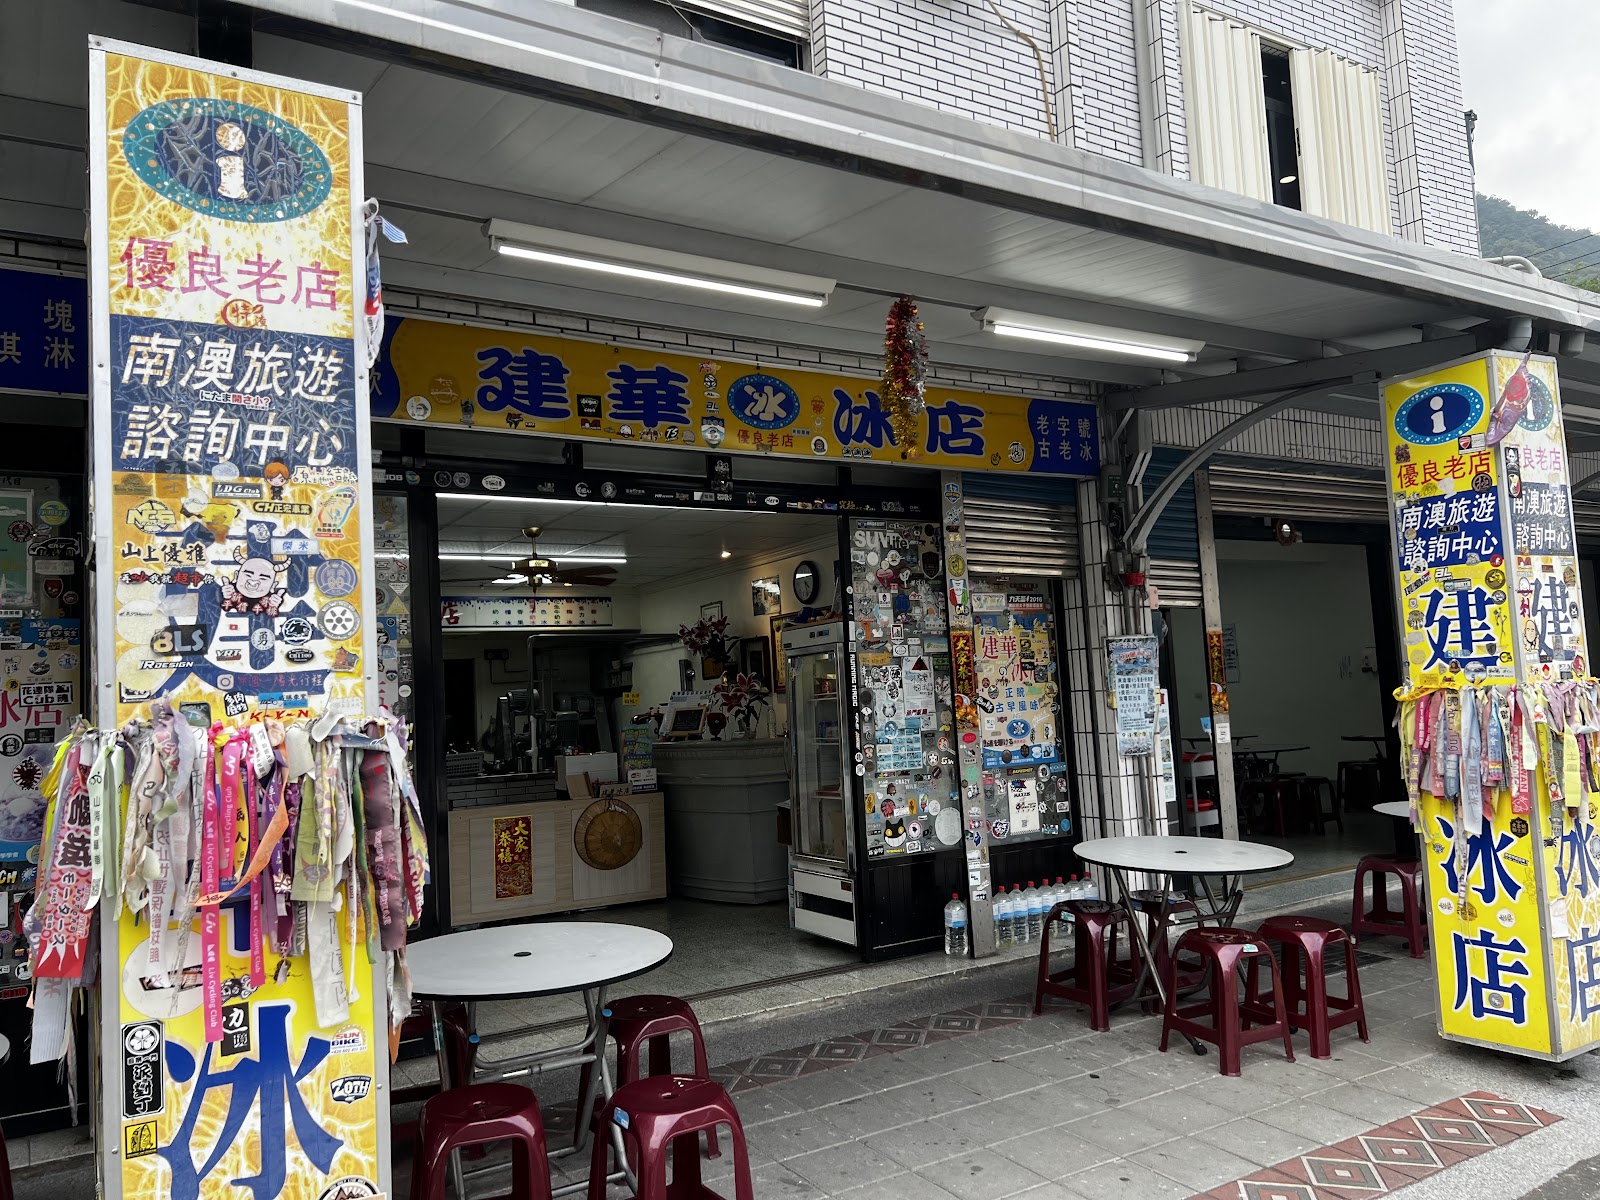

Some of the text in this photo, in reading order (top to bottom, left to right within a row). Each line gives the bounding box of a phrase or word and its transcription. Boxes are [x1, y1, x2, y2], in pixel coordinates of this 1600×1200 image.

[119, 235, 341, 312] 優良老店
[121, 331, 344, 403] 南澳旅遊
[476, 347, 691, 427] 建華
[120, 405, 342, 466] 諮詢中心
[737, 429, 794, 448] 優良老店
[1036, 413, 1092, 439] 老字號
[1037, 438, 1093, 462] 古老冰
[1509, 443, 1562, 471] 良老店
[1397, 450, 1491, 489] 優良老店
[215, 484, 242, 493] LDG
[1401, 492, 1496, 533] 南澳旅遊
[1404, 529, 1499, 566] 諮詢中心
[1515, 522, 1570, 550] 諮詢中心
[121, 542, 206, 564] 山上優雅
[1419, 586, 1496, 671] 建
[1530, 576, 1573, 660] 建
[981, 635, 1017, 659] 建華
[995, 700, 1039, 713] 古早風味
[1005, 687, 1025, 698] 正統
[225, 804, 233, 831] Cycling
[513, 820, 529, 853] 大家
[52, 873, 76, 948] モータース
[1436, 816, 1529, 1025] 冰店
[208, 980, 217, 1005] Cycling
[331, 1038, 360, 1046] BIKE
[157, 1004, 343, 1200] 冰
